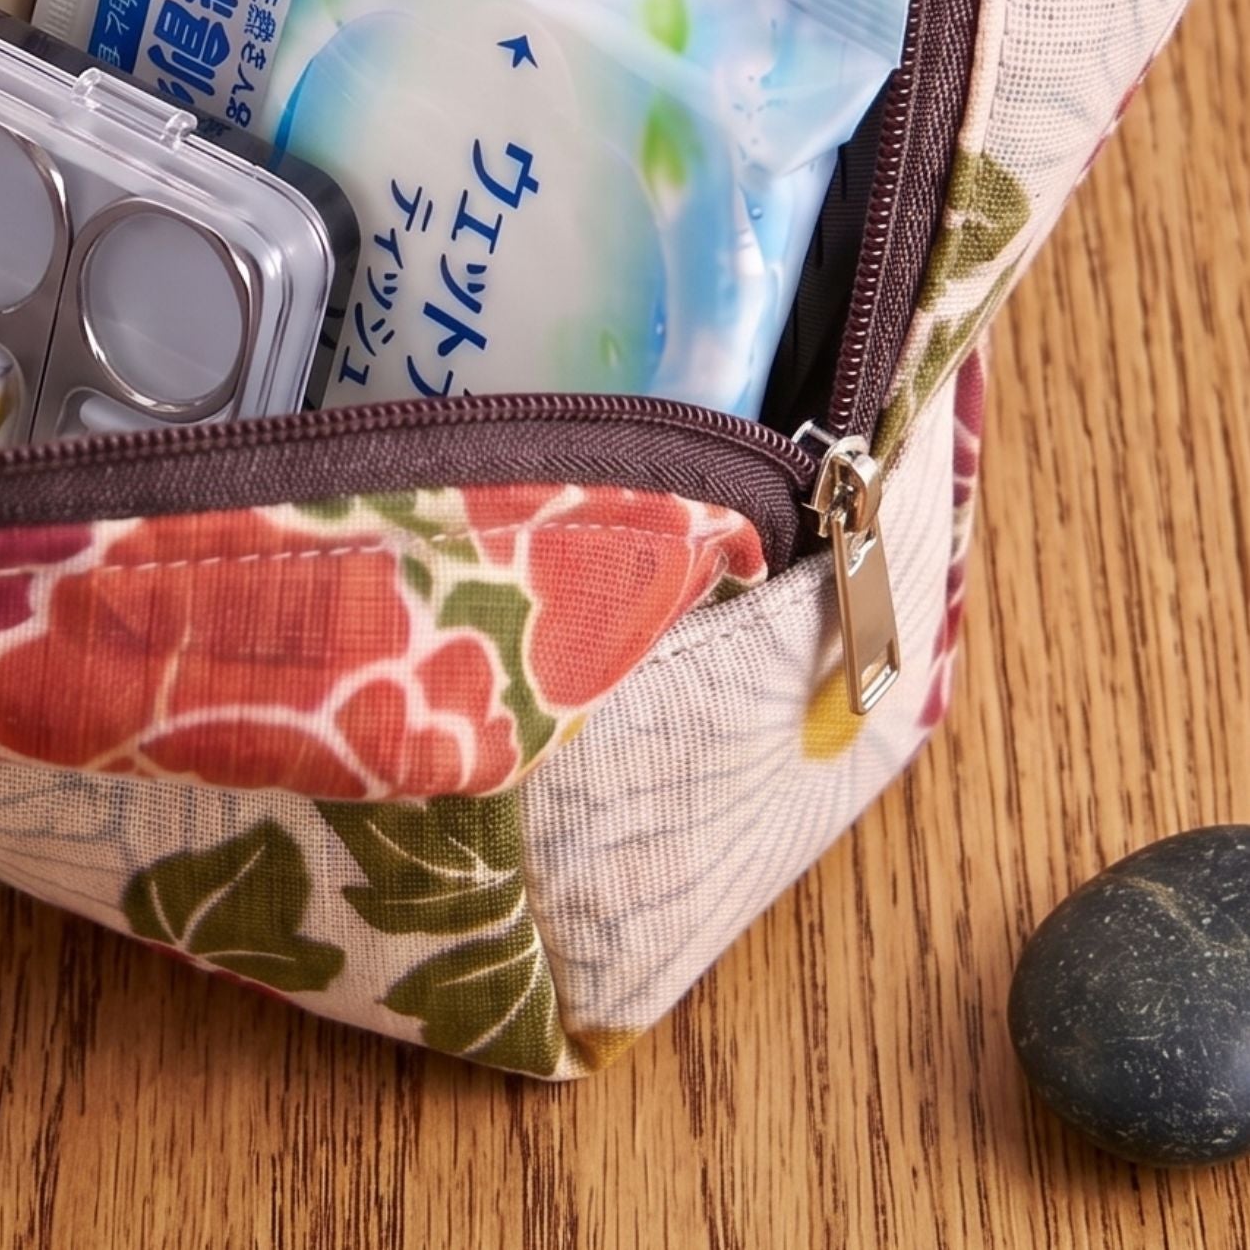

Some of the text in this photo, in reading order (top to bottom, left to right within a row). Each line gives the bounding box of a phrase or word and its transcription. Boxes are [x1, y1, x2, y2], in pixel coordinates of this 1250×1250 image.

[337, 178, 434, 387] ティッシュ
